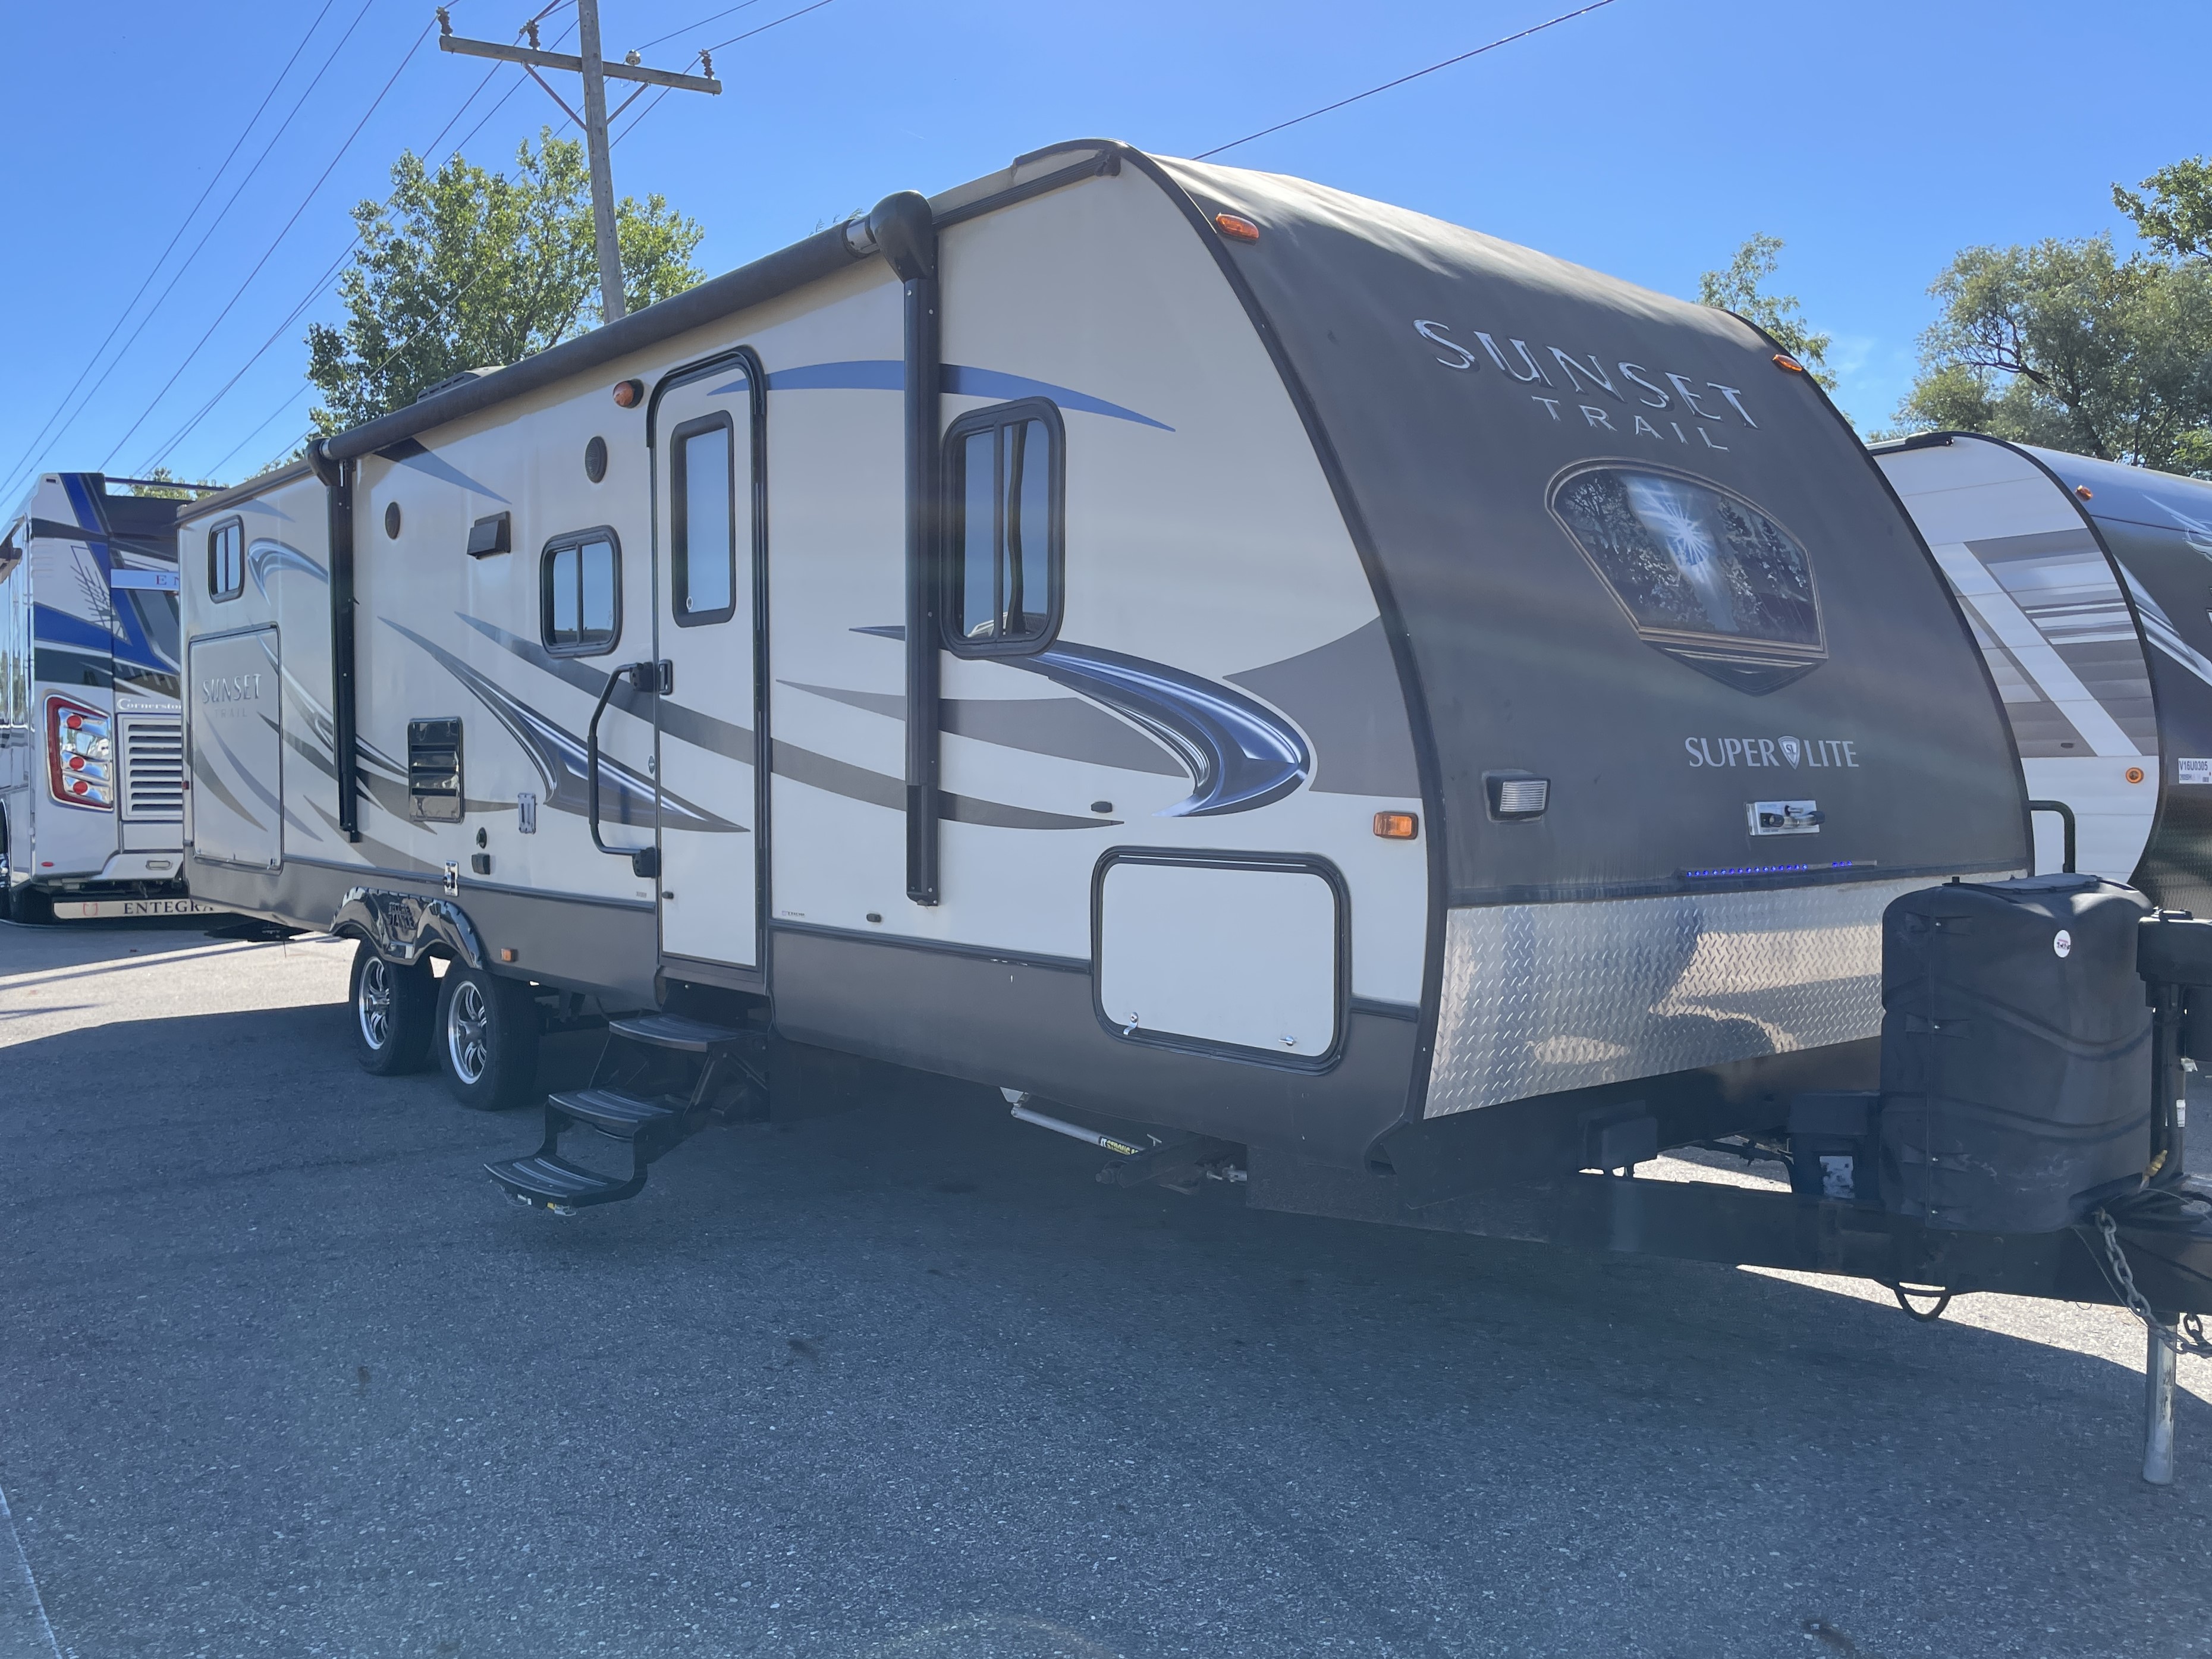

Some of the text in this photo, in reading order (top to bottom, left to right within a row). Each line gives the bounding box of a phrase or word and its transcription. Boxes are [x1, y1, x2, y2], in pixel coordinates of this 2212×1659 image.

[1413, 319, 1762, 431] SUNSET
[1531, 395, 1730, 453] TRAIL
[202, 673, 262, 704] SUNSET
[117, 698, 182, 711] Cornersto
[214, 708, 248, 718] TRAIL
[1684, 736, 1860, 768] SUPER LITE
[2179, 761, 2208, 771] V16U0305
